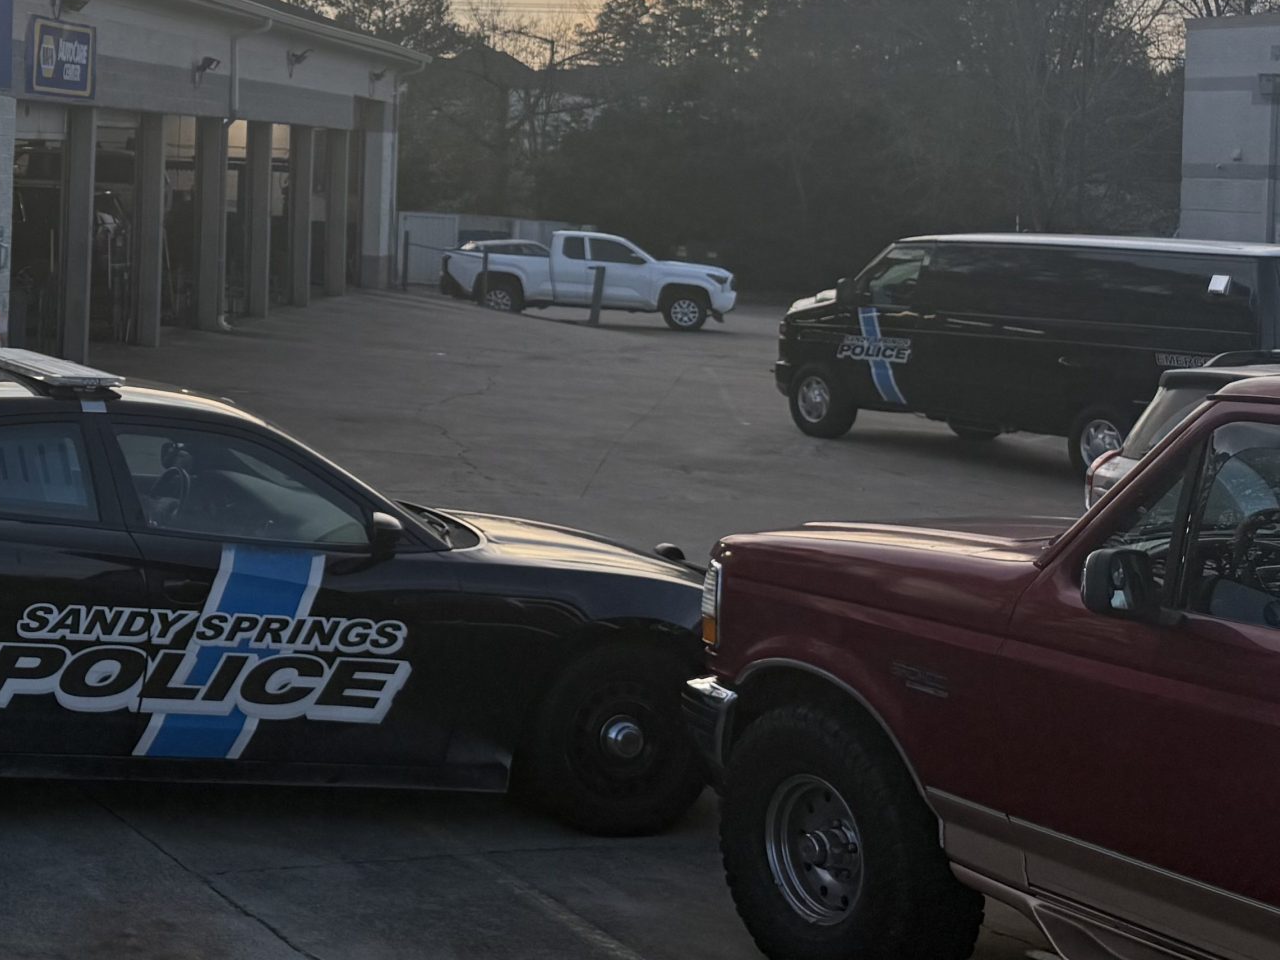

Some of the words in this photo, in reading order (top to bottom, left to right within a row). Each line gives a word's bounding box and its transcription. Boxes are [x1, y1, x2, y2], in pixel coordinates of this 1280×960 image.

[836, 343, 912, 363] POLICE
[17, 602, 200, 645] SANDY
[194, 611, 408, 654] SPRINGS
